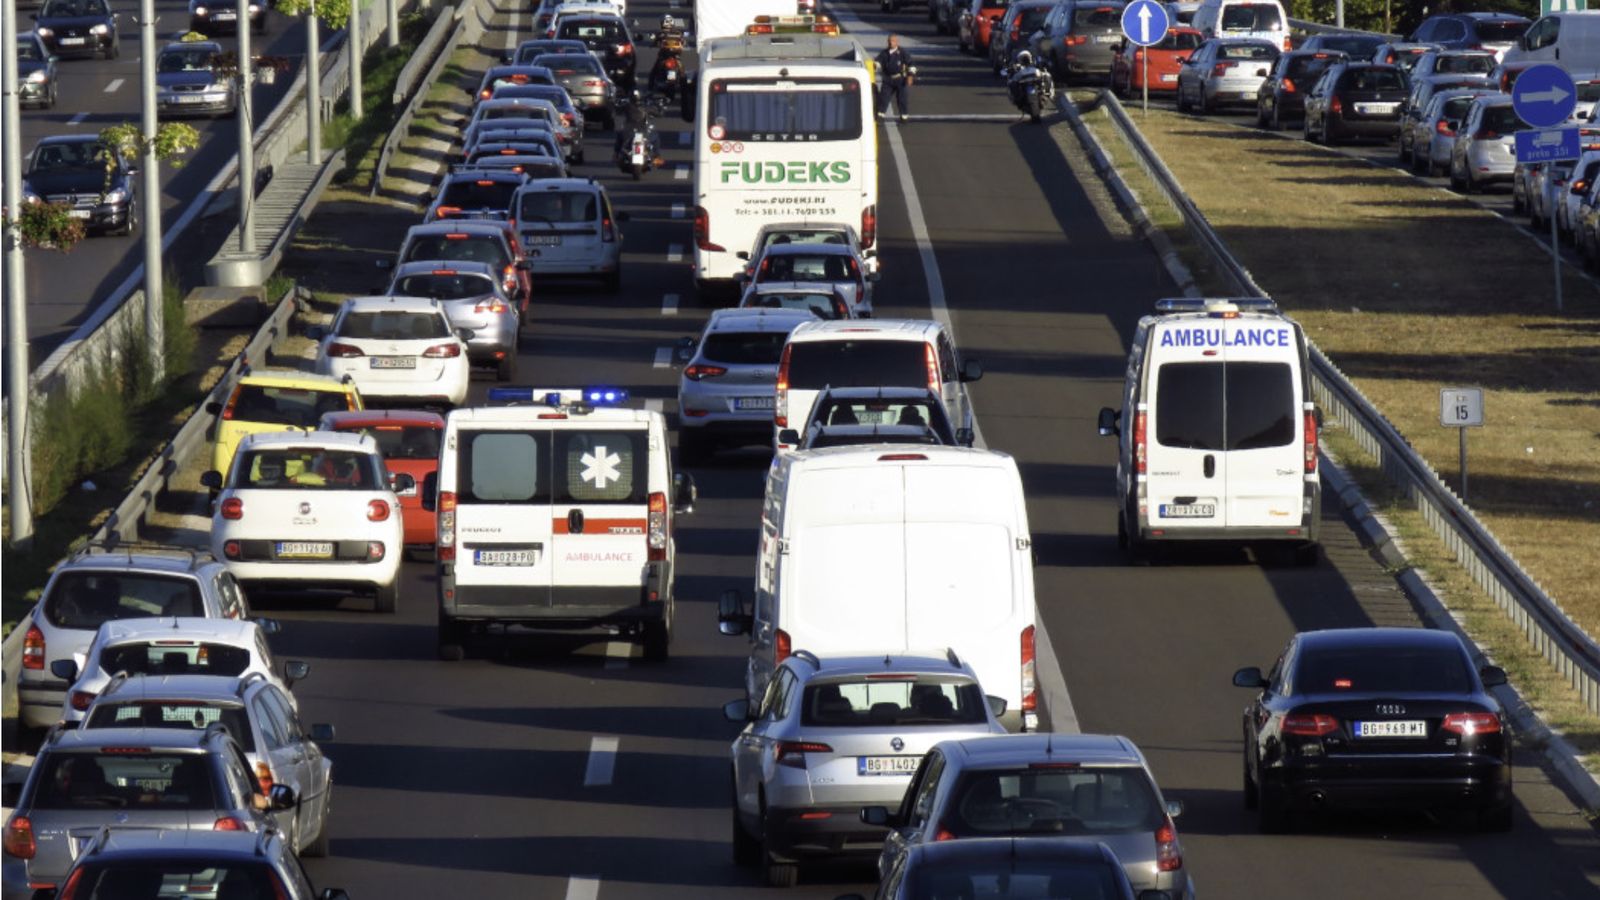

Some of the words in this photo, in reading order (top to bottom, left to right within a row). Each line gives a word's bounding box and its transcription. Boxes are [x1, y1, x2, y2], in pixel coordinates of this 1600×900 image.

[721, 161, 851, 183] FUDEKS
[1160, 329, 1289, 346] AMBULANCE
[1456, 405, 1468, 420] 15
[566, 552, 633, 561] AMBULANCE
[1363, 723, 1377, 734] BG
[868, 759, 881, 770] BG
